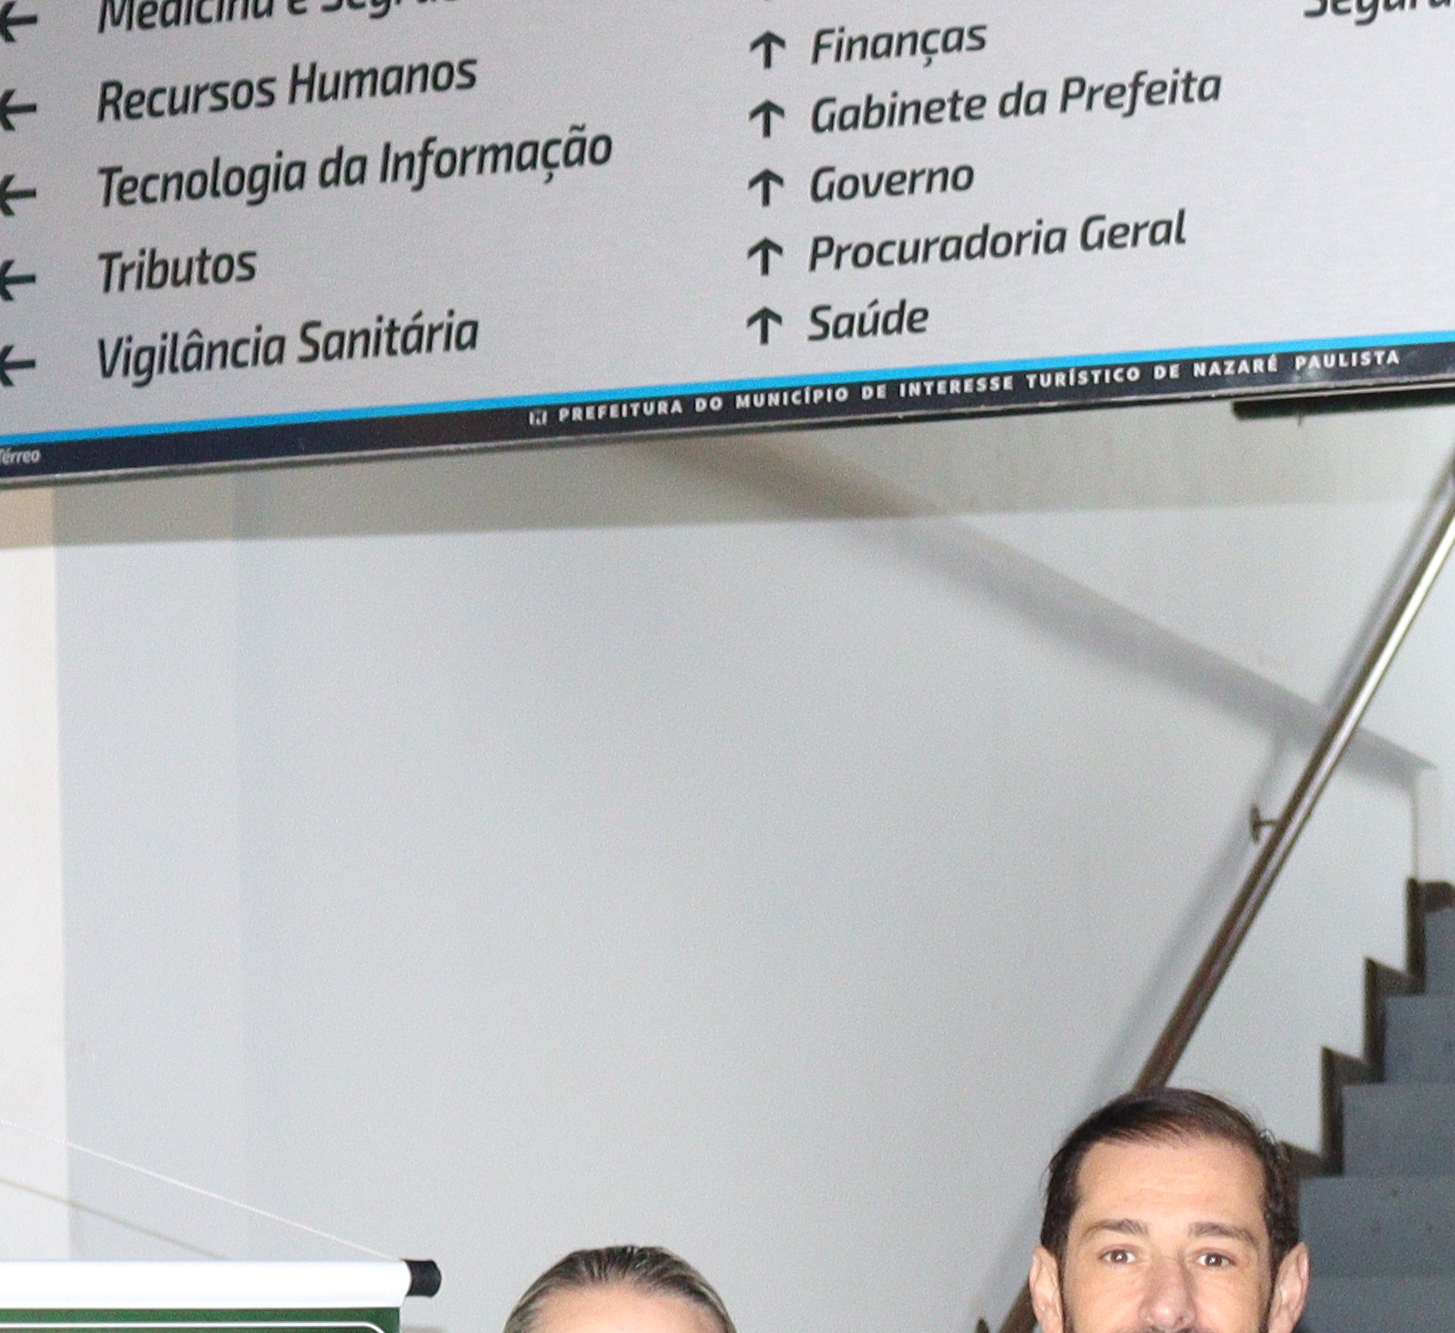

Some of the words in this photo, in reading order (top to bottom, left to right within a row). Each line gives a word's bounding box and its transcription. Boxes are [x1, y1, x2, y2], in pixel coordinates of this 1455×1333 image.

[810, 22, 988, 68] Finanças
[96, 73, 277, 123] Recursos
[288, 57, 478, 105] Humanos
[810, 87, 987, 134] Gabinete
[997, 83, 1048, 118] da
[1059, 70, 1223, 119] Prefeita
[97, 150, 307, 208] Tecnologia
[318, 146, 367, 190] da
[379, 124, 613, 192] Informação
[809, 162, 975, 203] Governo
[97, 246, 258, 293] Tributos
[808, 219, 1068, 272] Procuradoria
[1079, 209, 1188, 252] Geral
[97, 325, 287, 389] Vigilância
[297, 310, 479, 365] Sanitária
[807, 300, 930, 343] Saúde
[558, 400, 683, 423] PREFEITURA
[695, 397, 724, 413] DO
[735, 386, 849, 409] MUNICÍPIO
[861, 383, 887, 400] DE
[898, 375, 1014, 398] INTERESSE
[1025, 367, 1141, 390] TURÍSTICO
[1154, 363, 1181, 380] DE
[1193, 354, 1279, 378] NAZARÉ
[1295, 350, 1401, 371] PAULISTA
